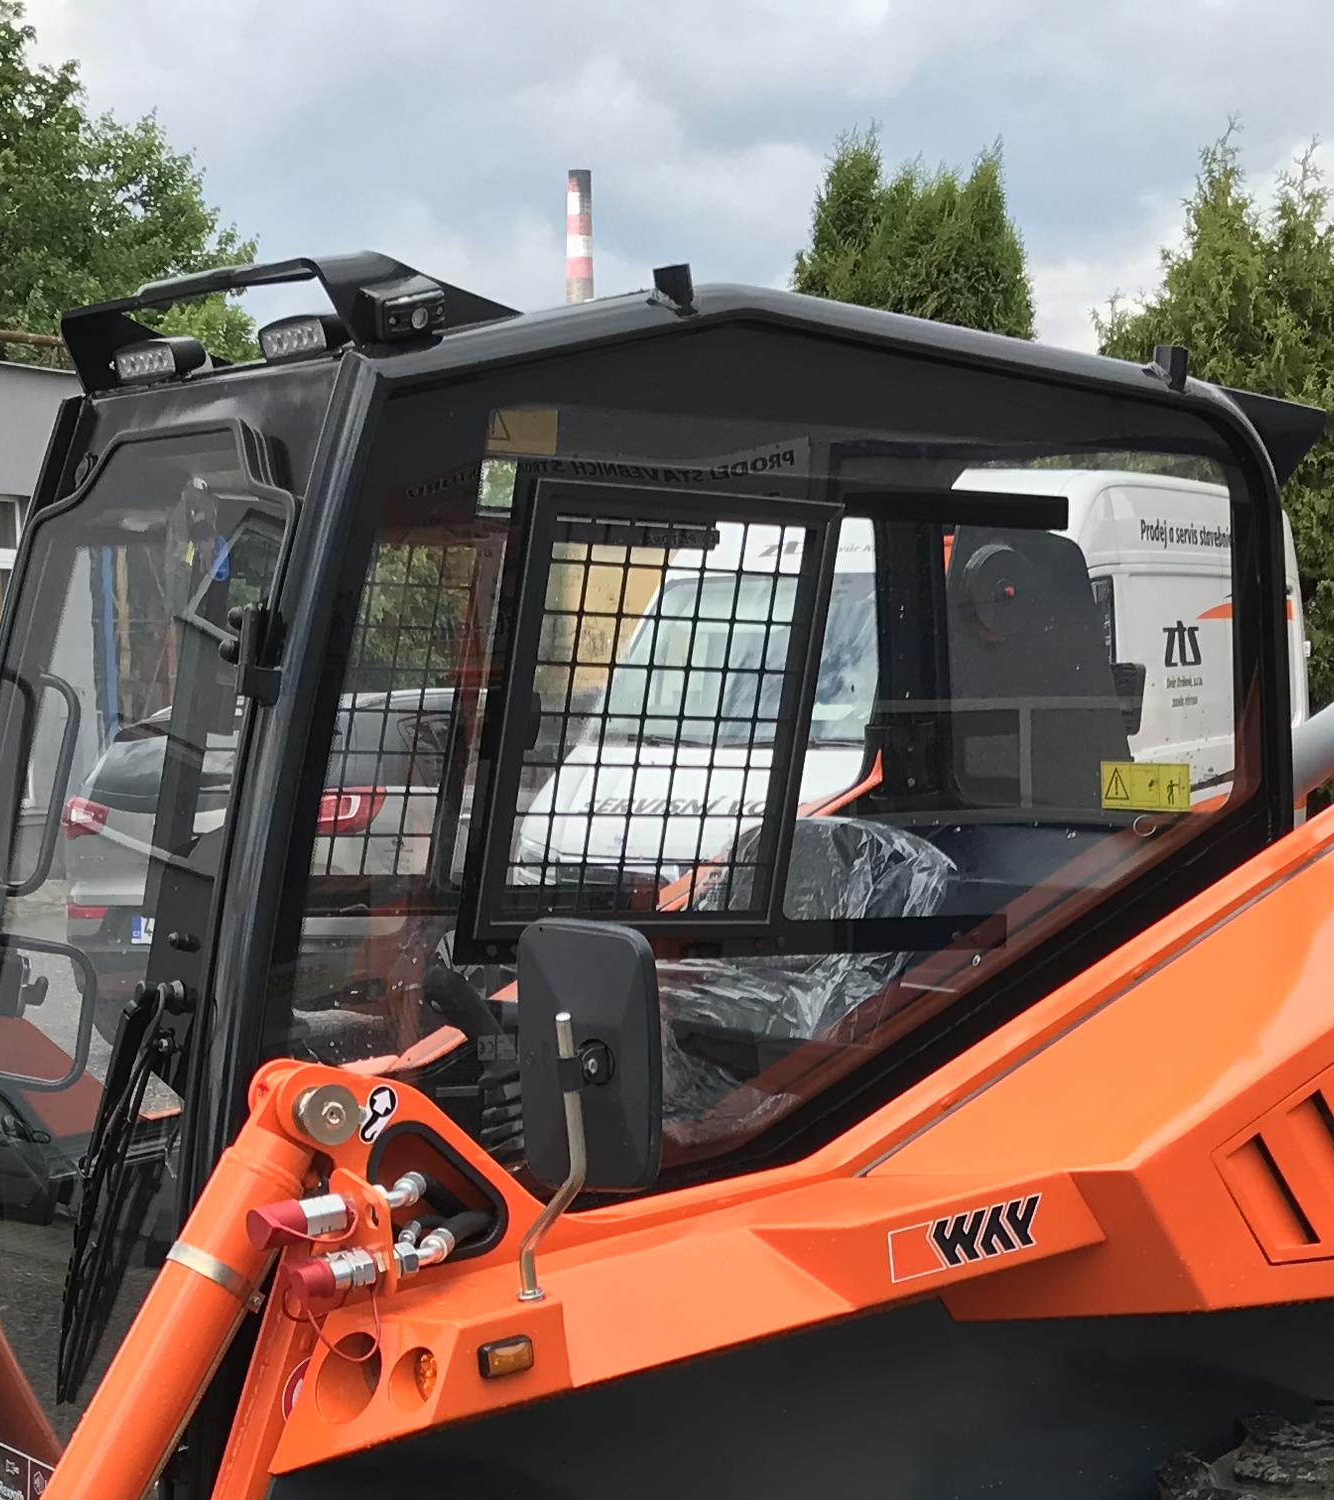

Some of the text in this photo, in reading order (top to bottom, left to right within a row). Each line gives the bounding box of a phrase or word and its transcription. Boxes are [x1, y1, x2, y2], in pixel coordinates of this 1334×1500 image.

[1139, 518, 1167, 549] Prodej
[1169, 527, 1174, 543] a
[1176, 522, 1198, 546] servis
[931, 1192, 1042, 1268] WAY
